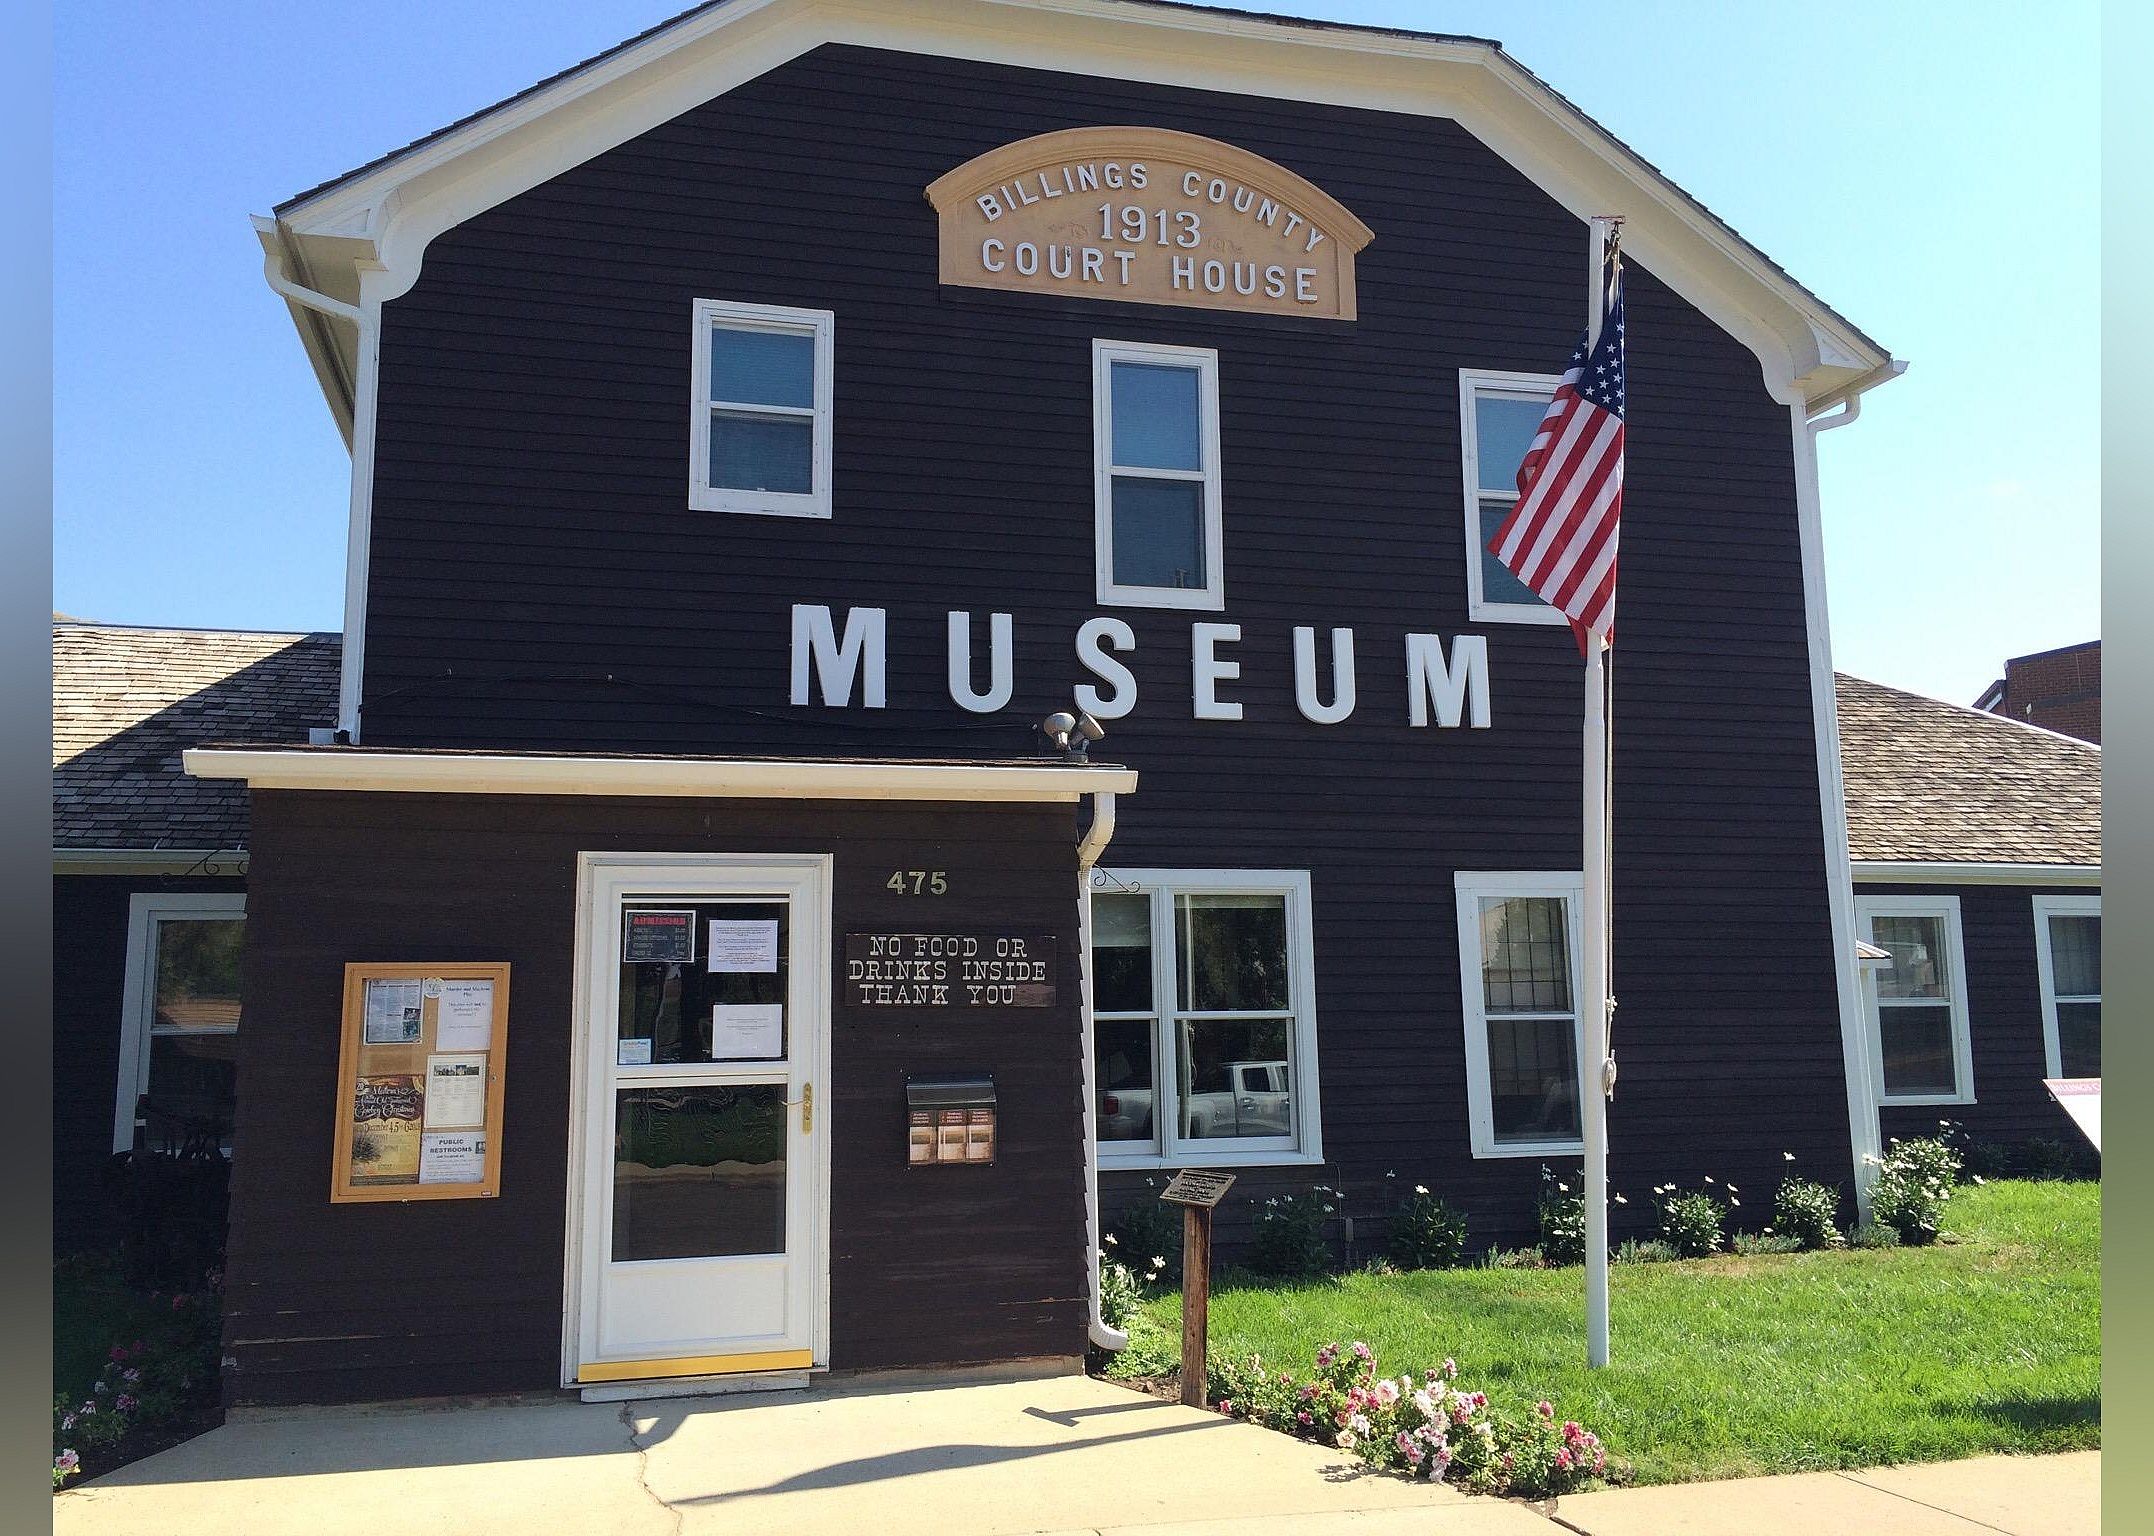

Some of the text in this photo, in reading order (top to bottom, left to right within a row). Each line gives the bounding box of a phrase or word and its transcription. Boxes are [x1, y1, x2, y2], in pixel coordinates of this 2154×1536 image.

[976, 162, 1326, 253] BILLINGS COUNTY
[1098, 202, 1202, 249] 1913
[981, 237, 1319, 302] COURT HOUSE
[789, 602, 1492, 729] MUSEUM
[886, 871, 948, 895] 475
[869, 936, 1028, 958] NO FOOD OR
[848, 959, 1047, 981] DRINKS INSIDE
[858, 983, 1017, 1005] THANK YOU
[429, 1146, 473, 1154] RESTROOMS
[438, 1138, 465, 1146] PUBLIC
